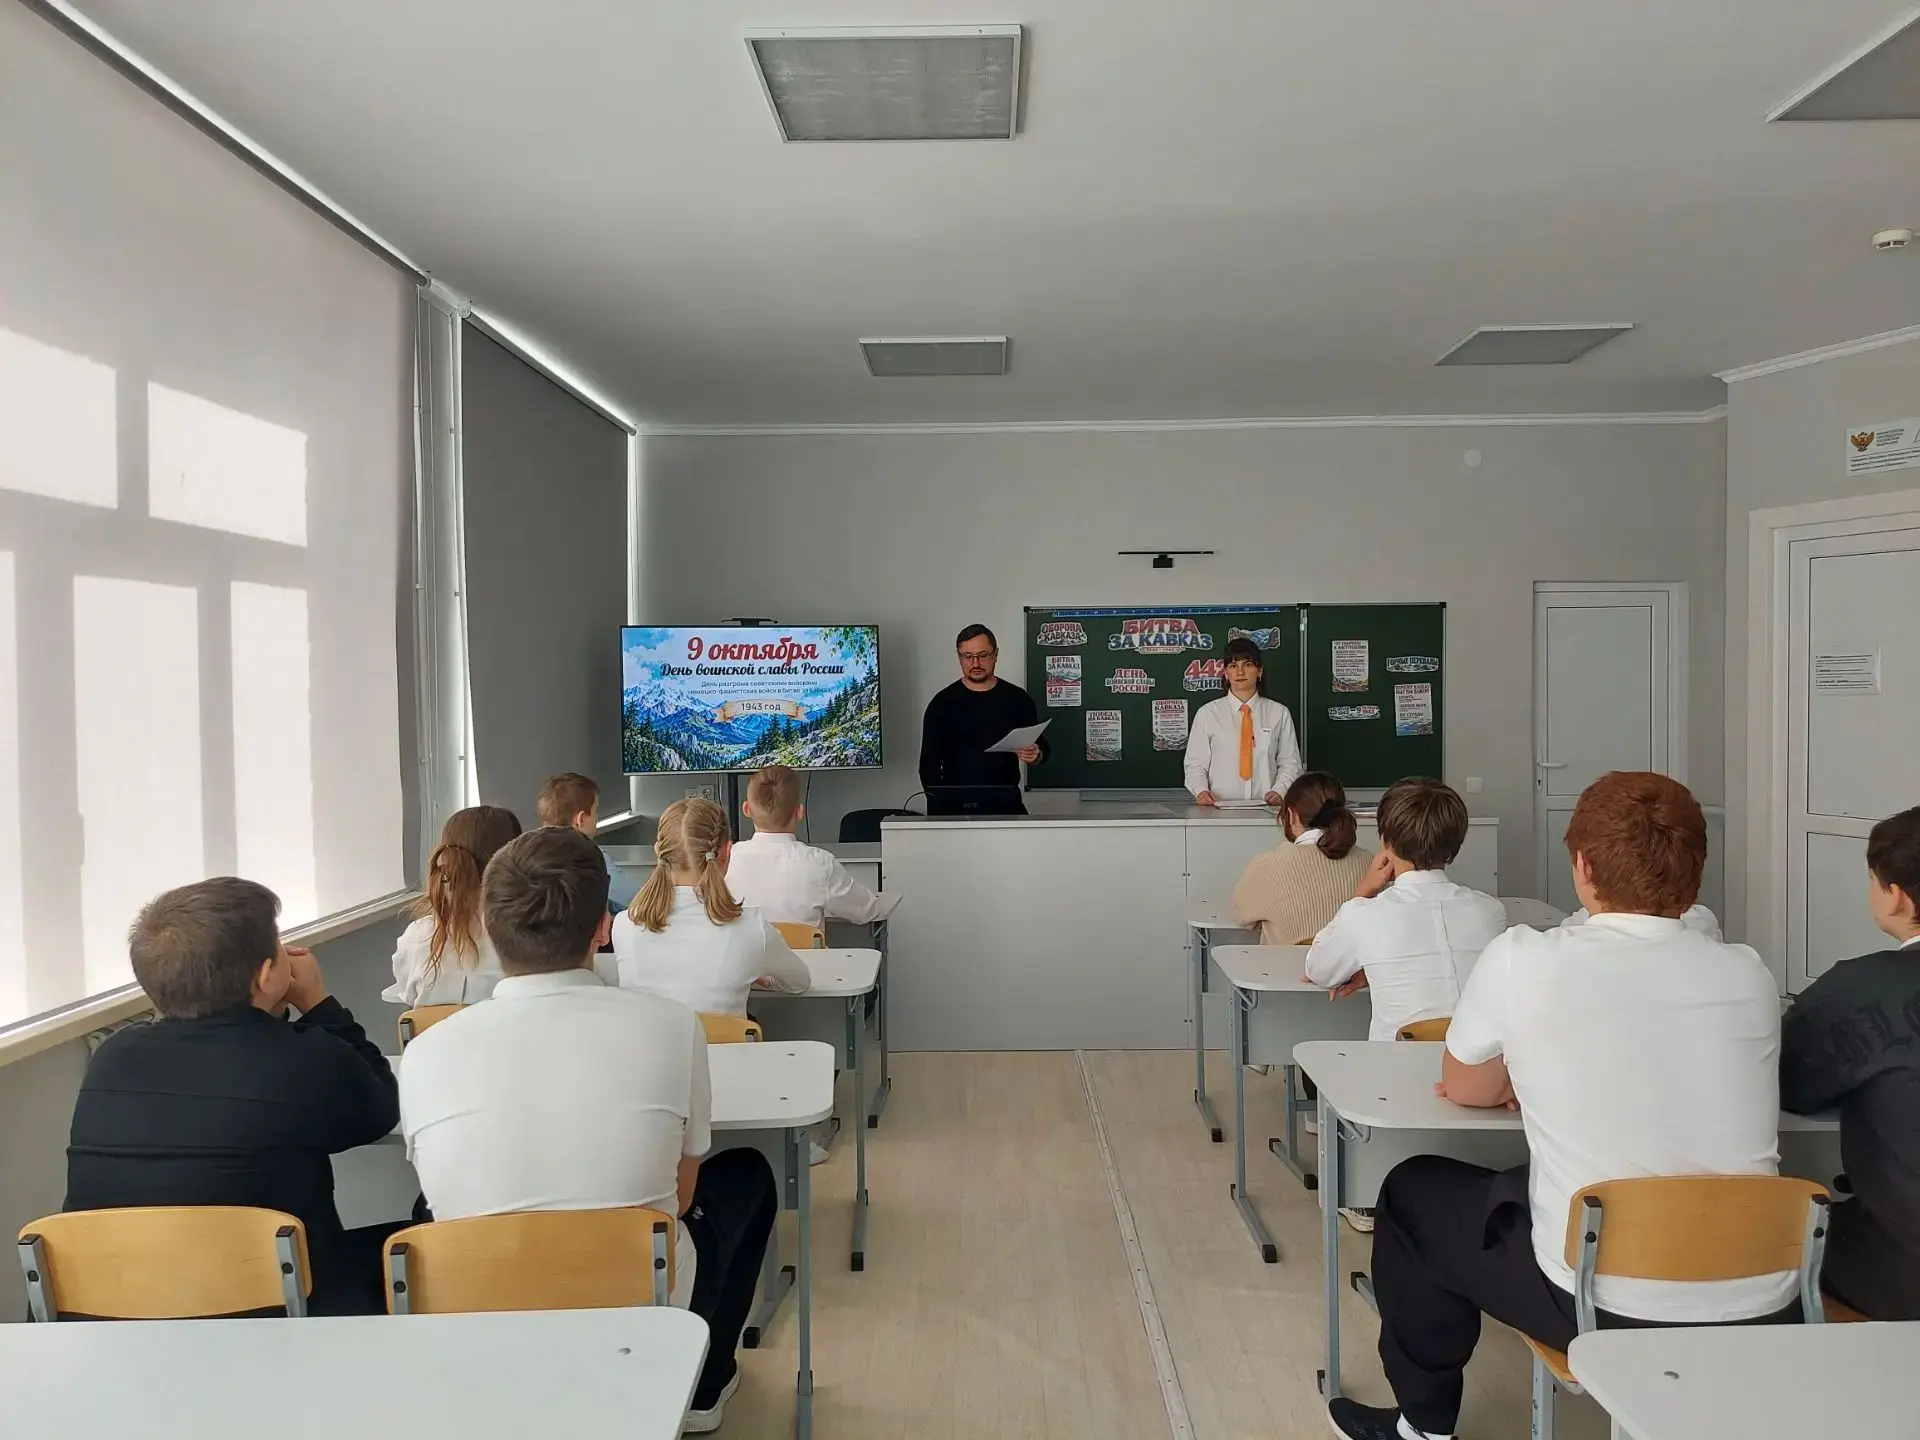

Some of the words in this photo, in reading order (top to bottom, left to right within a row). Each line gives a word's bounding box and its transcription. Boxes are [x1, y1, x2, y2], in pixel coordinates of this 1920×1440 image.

[1041, 623, 1083, 633] ОБОРОНА
[1122, 619, 1197, 635] БИТВА
[1044, 631, 1081, 640] КАВКАЗА
[1109, 634, 1136, 649] ЗА
[1139, 633, 1212, 648] КАВКАЗ
[687, 636, 704, 660] 9
[708, 636, 819, 666] октября
[660, 663, 693, 676] День
[695, 663, 756, 676] воинской
[758, 663, 799, 675] славы
[801, 662, 845, 675] России
[1114, 669, 1146, 679] ДЕНЬ
[1112, 685, 1149, 693] РОССИИ
[1197, 679, 1221, 691] ДНЯ
[741, 703, 763, 711] 1943
[764, 704, 781, 712] год
